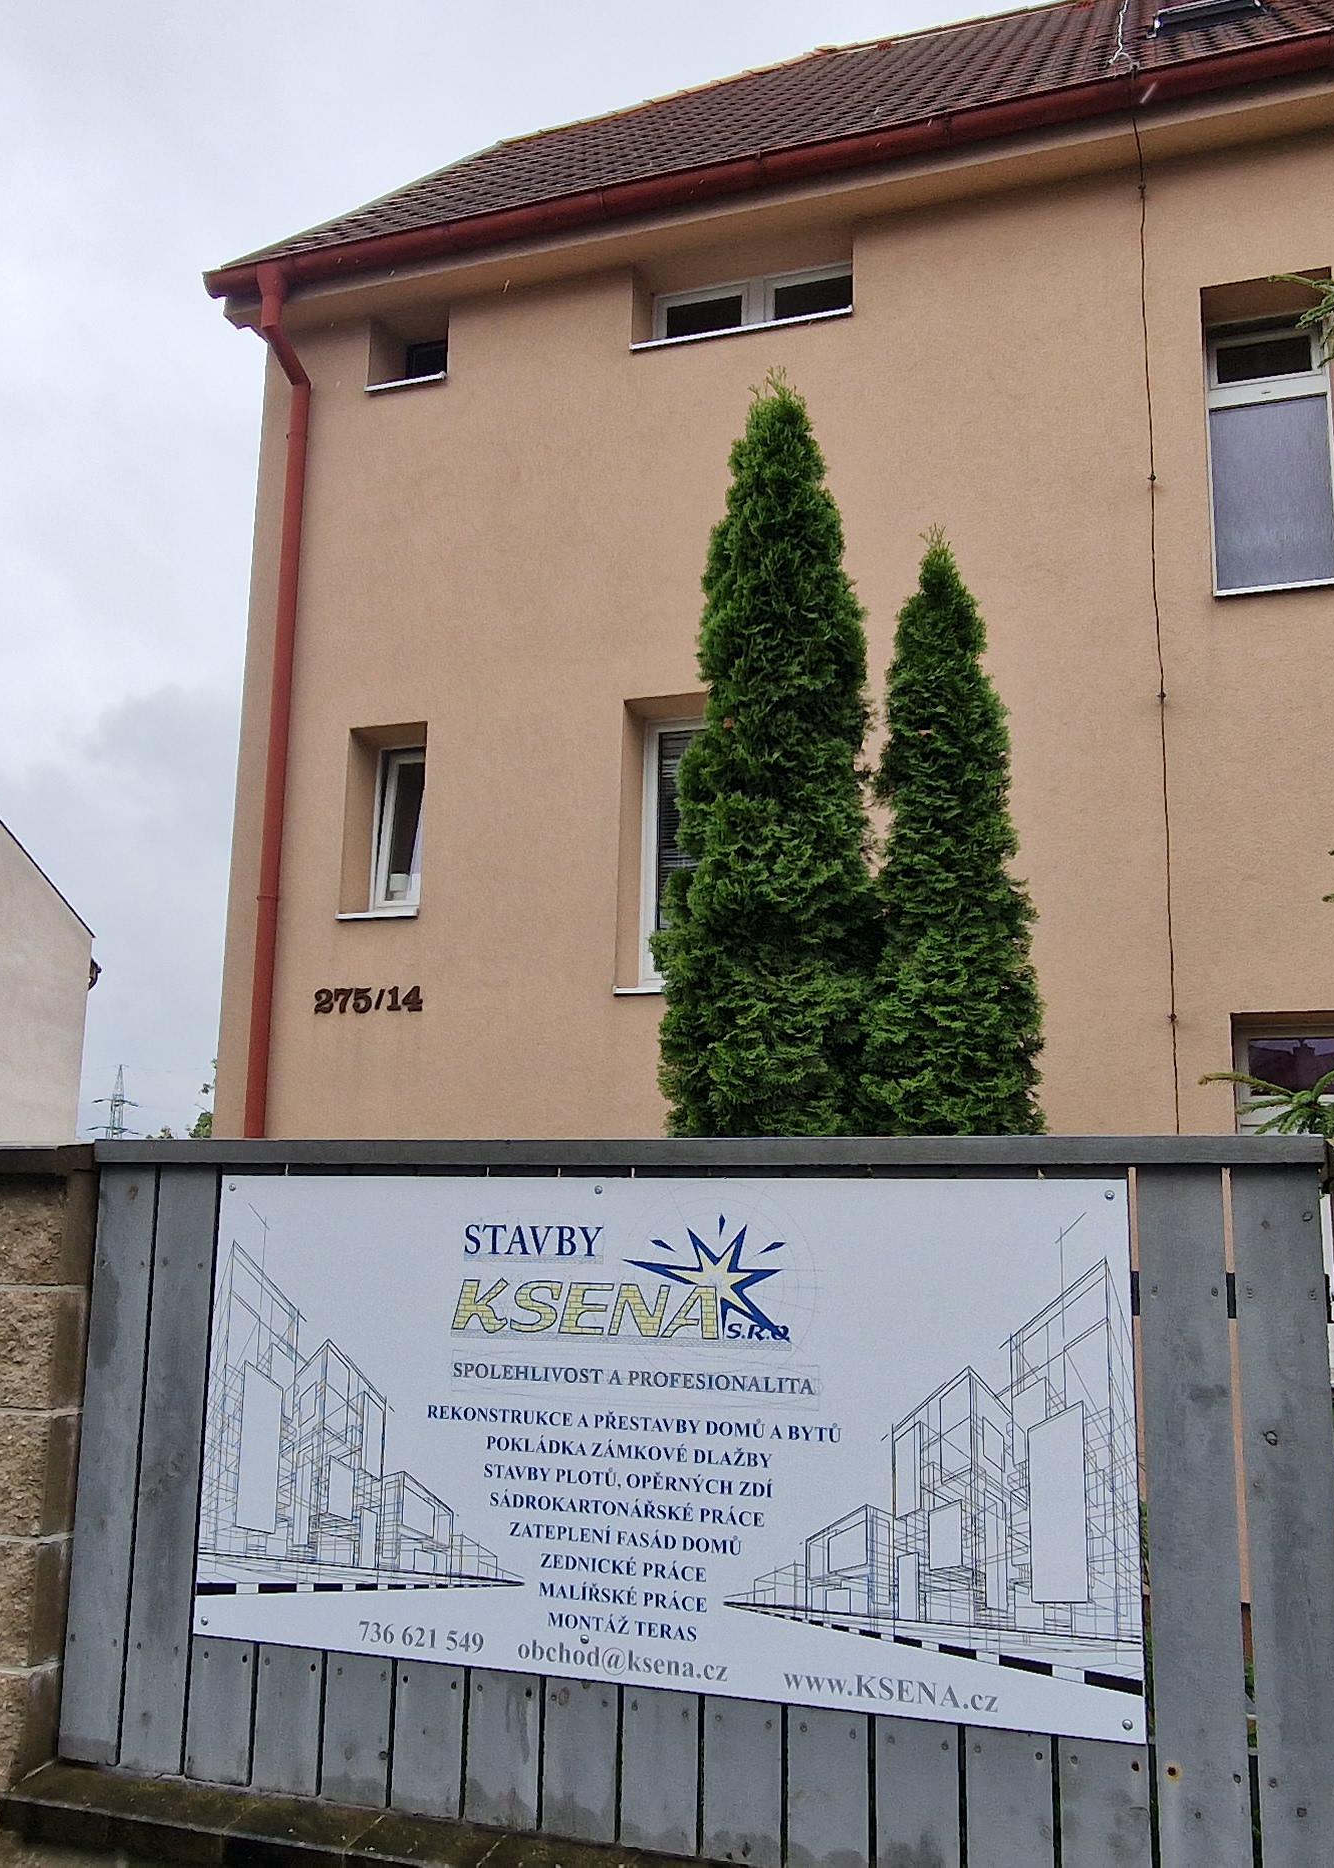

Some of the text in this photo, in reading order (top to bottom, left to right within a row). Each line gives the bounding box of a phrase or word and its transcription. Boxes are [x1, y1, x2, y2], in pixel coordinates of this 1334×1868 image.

[314, 985, 423, 1014] 275/14
[464, 1224, 603, 1257] STAVBY
[451, 1278, 720, 1340] KSENA
[453, 1362, 815, 1395] SPOLEHLIVOST A PROFESIONALITA
[427, 1404, 843, 1443] REKONSTRUKCE A PŘESTAVBY DOMŮ A BYTŮ
[486, 1433, 773, 1469] POKLÁDKA ZÁMKOVÉ DLAŽBY
[483, 1463, 773, 1498] STAVBY PLOTŮ, OPĚRNÝCH ZDÍ
[489, 1491, 765, 1528] SÁDROKARTONÁŘSKÉ PRÁCE
[509, 1521, 742, 1556] ZATEPLENÍ FASÁD DOMŮ
[540, 1552, 707, 1583] ZEDNICKÉ PRÁCE
[538, 1580, 708, 1612] MALÍŘSKÉ PRÁCE
[358, 1620, 484, 1653] 736 621 549
[547, 1611, 697, 1642] MONTÁŽ TERAS
[518, 1640, 729, 1683] obchod@ksena.cz
[783, 1672, 999, 1713] www.KSENA.cz
